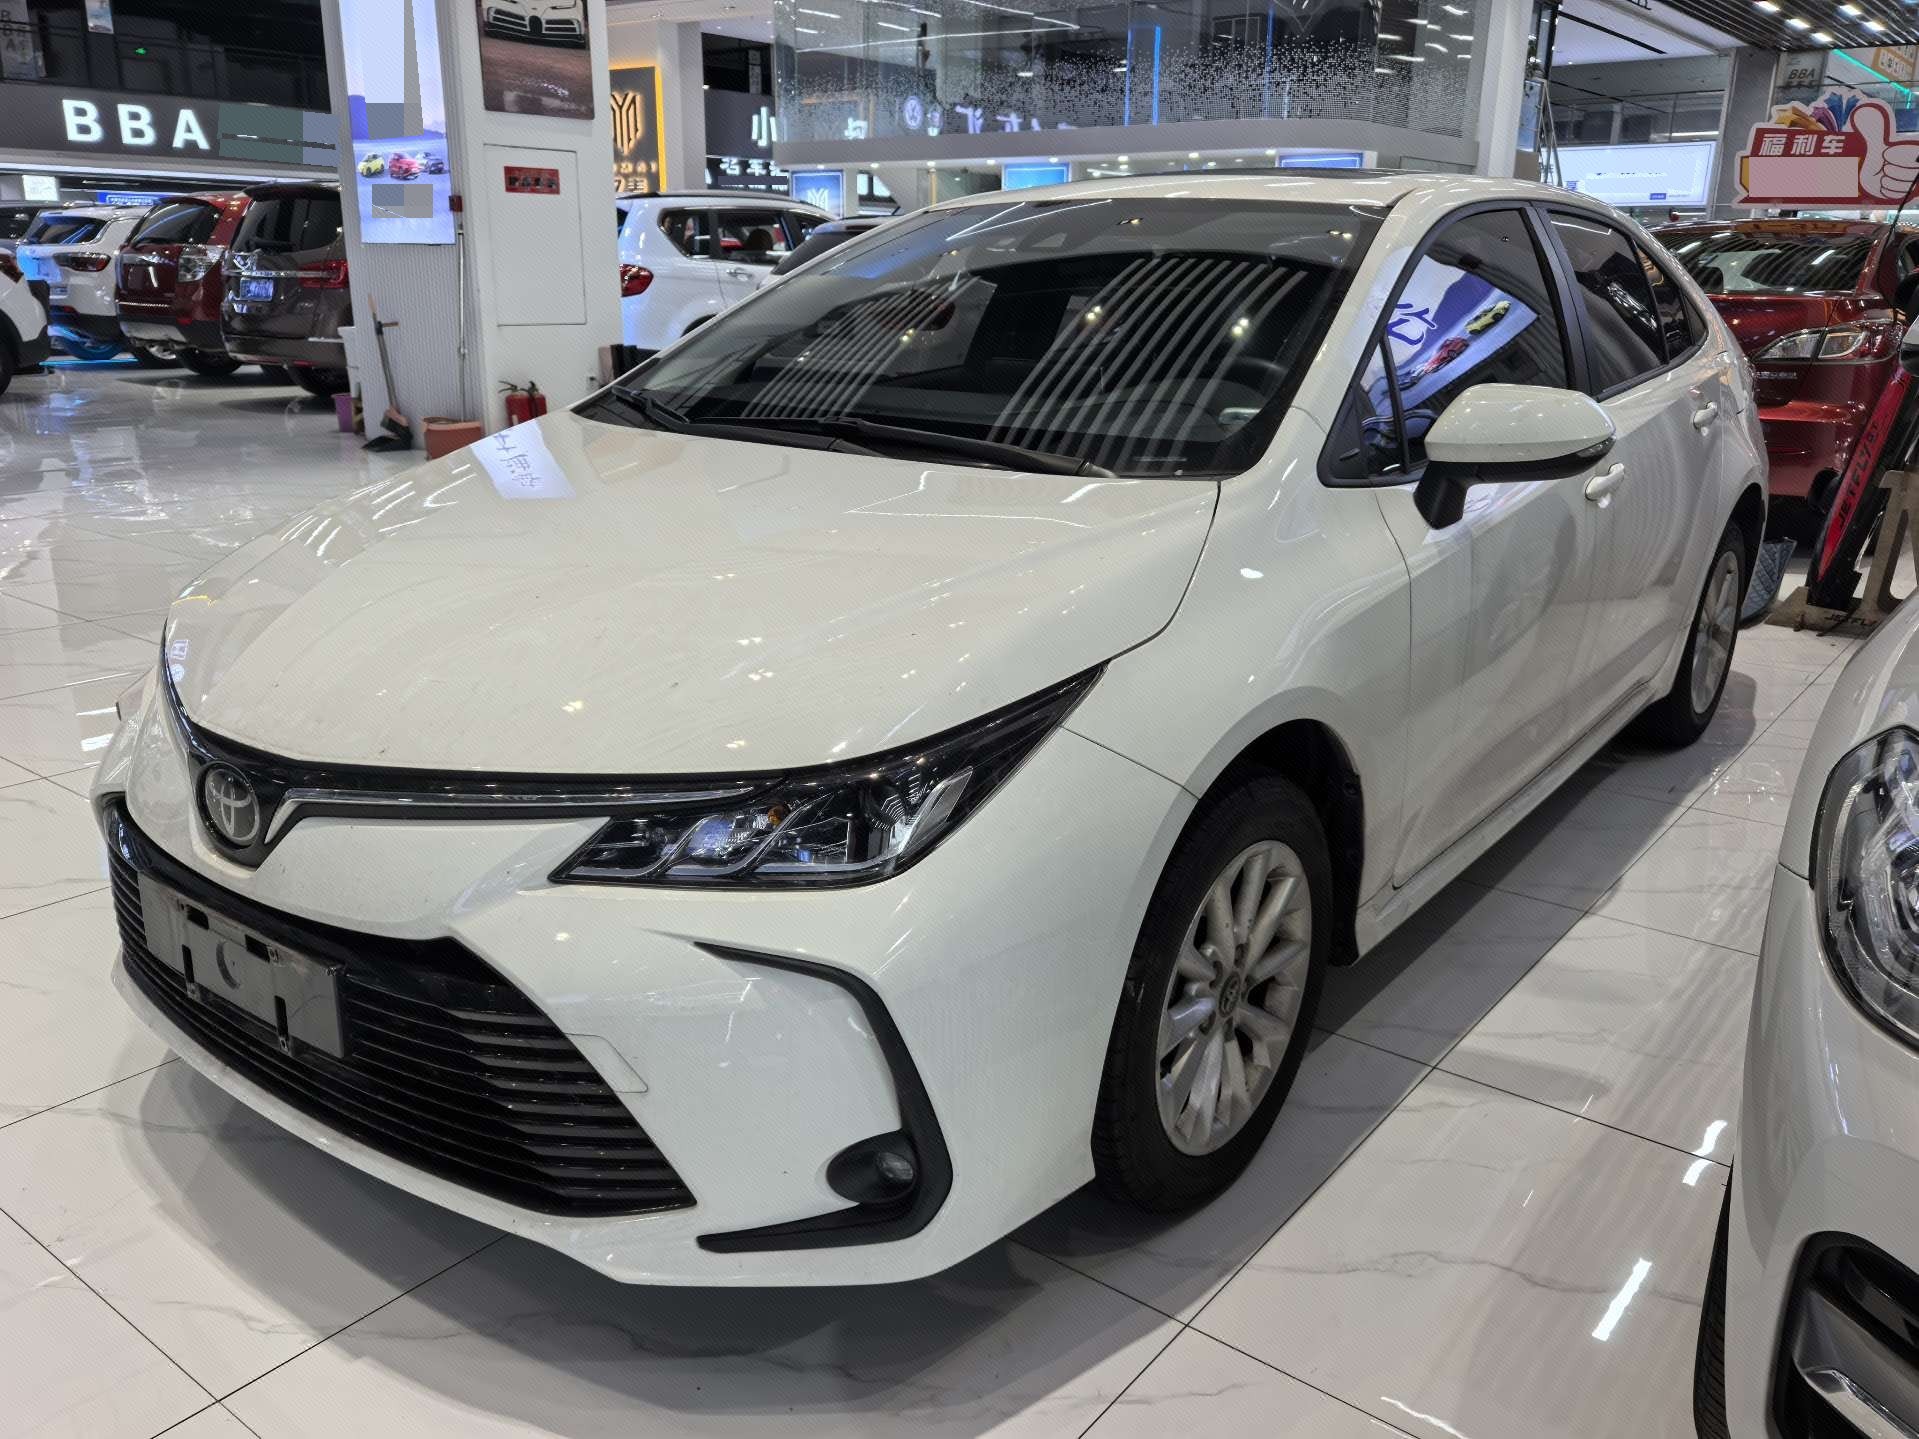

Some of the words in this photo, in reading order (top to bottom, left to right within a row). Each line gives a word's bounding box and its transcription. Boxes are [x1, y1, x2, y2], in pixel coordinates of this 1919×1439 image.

[62, 99, 210, 150] BBA
[1759, 133, 1846, 156] 福利车
